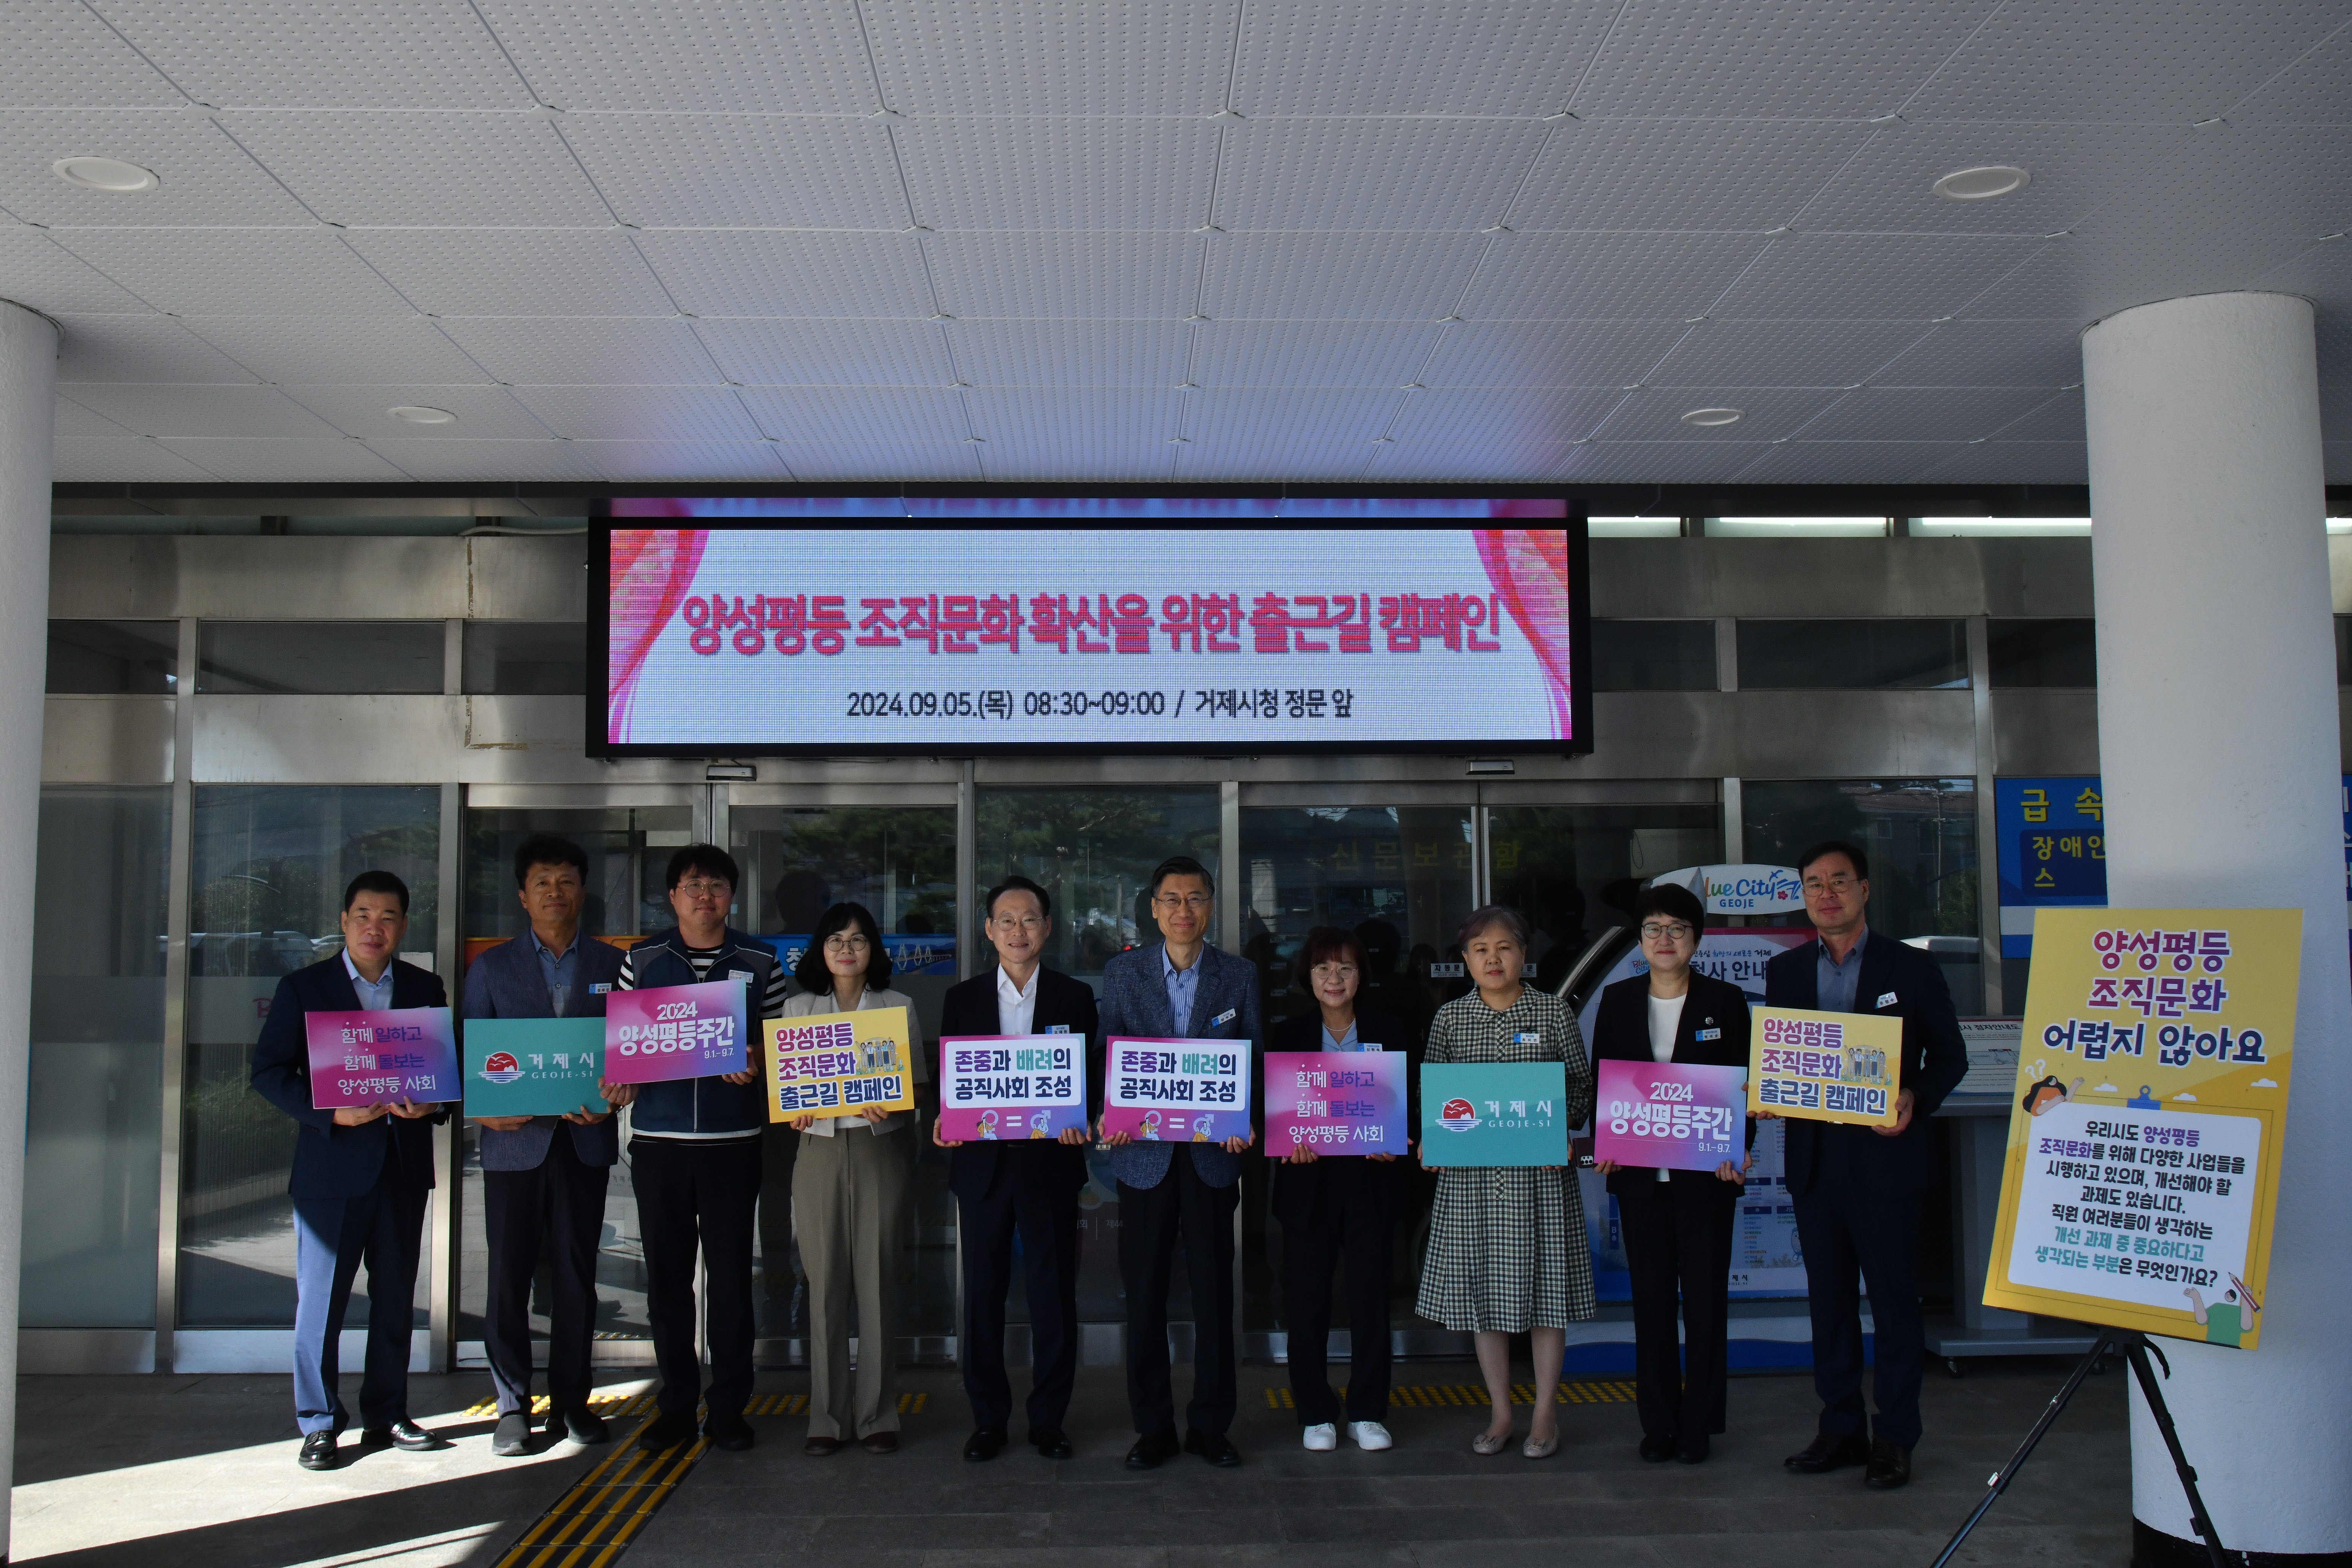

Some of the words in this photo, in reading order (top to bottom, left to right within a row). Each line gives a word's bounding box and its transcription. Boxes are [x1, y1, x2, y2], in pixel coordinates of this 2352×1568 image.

[684, 594, 851, 655] 양성평등
[855, 593, 1024, 654] 조직문화
[1028, 592, 1154, 653] 확산을
[1160, 593, 1244, 653] 위한
[1248, 591, 1372, 653] 출근길
[1378, 593, 1500, 653] 캠페인
[847, 690, 1013, 720] 2024.09.05.(목)
[1024, 691, 1165, 716] 08:30~09:00
[1173, 690, 1185, 718] /
[1195, 689, 1279, 718] 거제시청
[1285, 689, 1328, 718] 정문
[1331, 689, 1353, 718] 앞
[1706, 877, 1735, 897] lue
[1736, 879, 1776, 901] City
[1720, 898, 1754, 909] GEOJE
[2093, 930, 2231, 972] 양성평등
[656, 1001, 698, 1021] 2024
[2088, 977, 2227, 1017] 조직문화
[341, 1027, 373, 1044] 함께
[375, 1026, 422, 1043] 일하고
[619, 1016, 735, 1056] 양성평등주간
[776, 1022, 854, 1053] 양성평등
[1763, 1018, 1843, 1049] 양성평등
[2044, 1019, 2145, 1060] 어렵지
[2158, 1024, 2266, 1067] 않아요
[343, 1054, 376, 1071] 함께
[378, 1053, 425, 1070] 돌보는
[528, 1052, 594, 1070] 거제시
[778, 1051, 856, 1081] 조직문화
[955, 1049, 1011, 1072] 존중과
[1016, 1048, 1071, 1071] 배려의
[1121, 1050, 1177, 1074] 존중과
[1182, 1053, 1236, 1075] 배려의
[1761, 1048, 1842, 1079] 조직문화
[338, 1076, 401, 1095] 양성평등
[405, 1074, 436, 1091] 사회
[531, 1070, 593, 1079] GEOJE-SI
[955, 1076, 1029, 1100] 공직사회
[1035, 1075, 1072, 1098] 조성
[1296, 1070, 1327, 1088] 함께
[1330, 1070, 1375, 1087] 일하고
[780, 1081, 839, 1110] 출근길
[844, 1075, 902, 1104] 캠페인
[1120, 1077, 1193, 1101] 공직사회
[1199, 1081, 1236, 1102] 조성
[1649, 1081, 1694, 1102] 2024
[1760, 1078, 1819, 1108] 출근길
[1825, 1085, 1886, 1115] 캠페인
[1296, 1100, 1327, 1118] 함께
[1330, 1100, 1375, 1117] 돌보는
[1484, 1100, 1552, 1118] 거제시
[1610, 1100, 1733, 1141] 양성평등주간
[1289, 1125, 1350, 1144] 양성평등
[1353, 1125, 1384, 1143] 사회
[1489, 1120, 1550, 1128] GEOJE-SI
[2085, 1120, 2139, 1141] 우리시도
[2143, 1125, 2200, 1148] 양성평등
[2039, 1137, 2105, 1160] 조직문화를
[2108, 1144, 2136, 1163] 위해
[2140, 1147, 2184, 1168] 다양한
[2186, 1152, 2246, 1174] 사업들을
[2046, 1160, 2101, 1182] 시행하고
[2104, 1166, 2148, 1190] 있으며,
[2154, 1171, 2213, 1193] 개선해야
[2216, 1178, 2232, 1196] 할
[2080, 1185, 2122, 1206] 과제도
[2125, 1190, 2186, 1214] 있습니다.
[2052, 1203, 2079, 1223] 직원
[2082, 1207, 2151, 1232] 여러분들이
[2154, 1216, 2214, 1240] 생각하는
[2054, 1225, 2082, 1245] 개선
[2083, 1230, 2113, 1250] 과제
[2116, 1234, 2130, 1252] 중
[2133, 1236, 2205, 1262] 중요하다고
[2034, 1245, 2089, 1268] 생각되는
[2092, 1253, 2132, 1275] 부분은
[2135, 1259, 2218, 1288] 무엇인가요?
